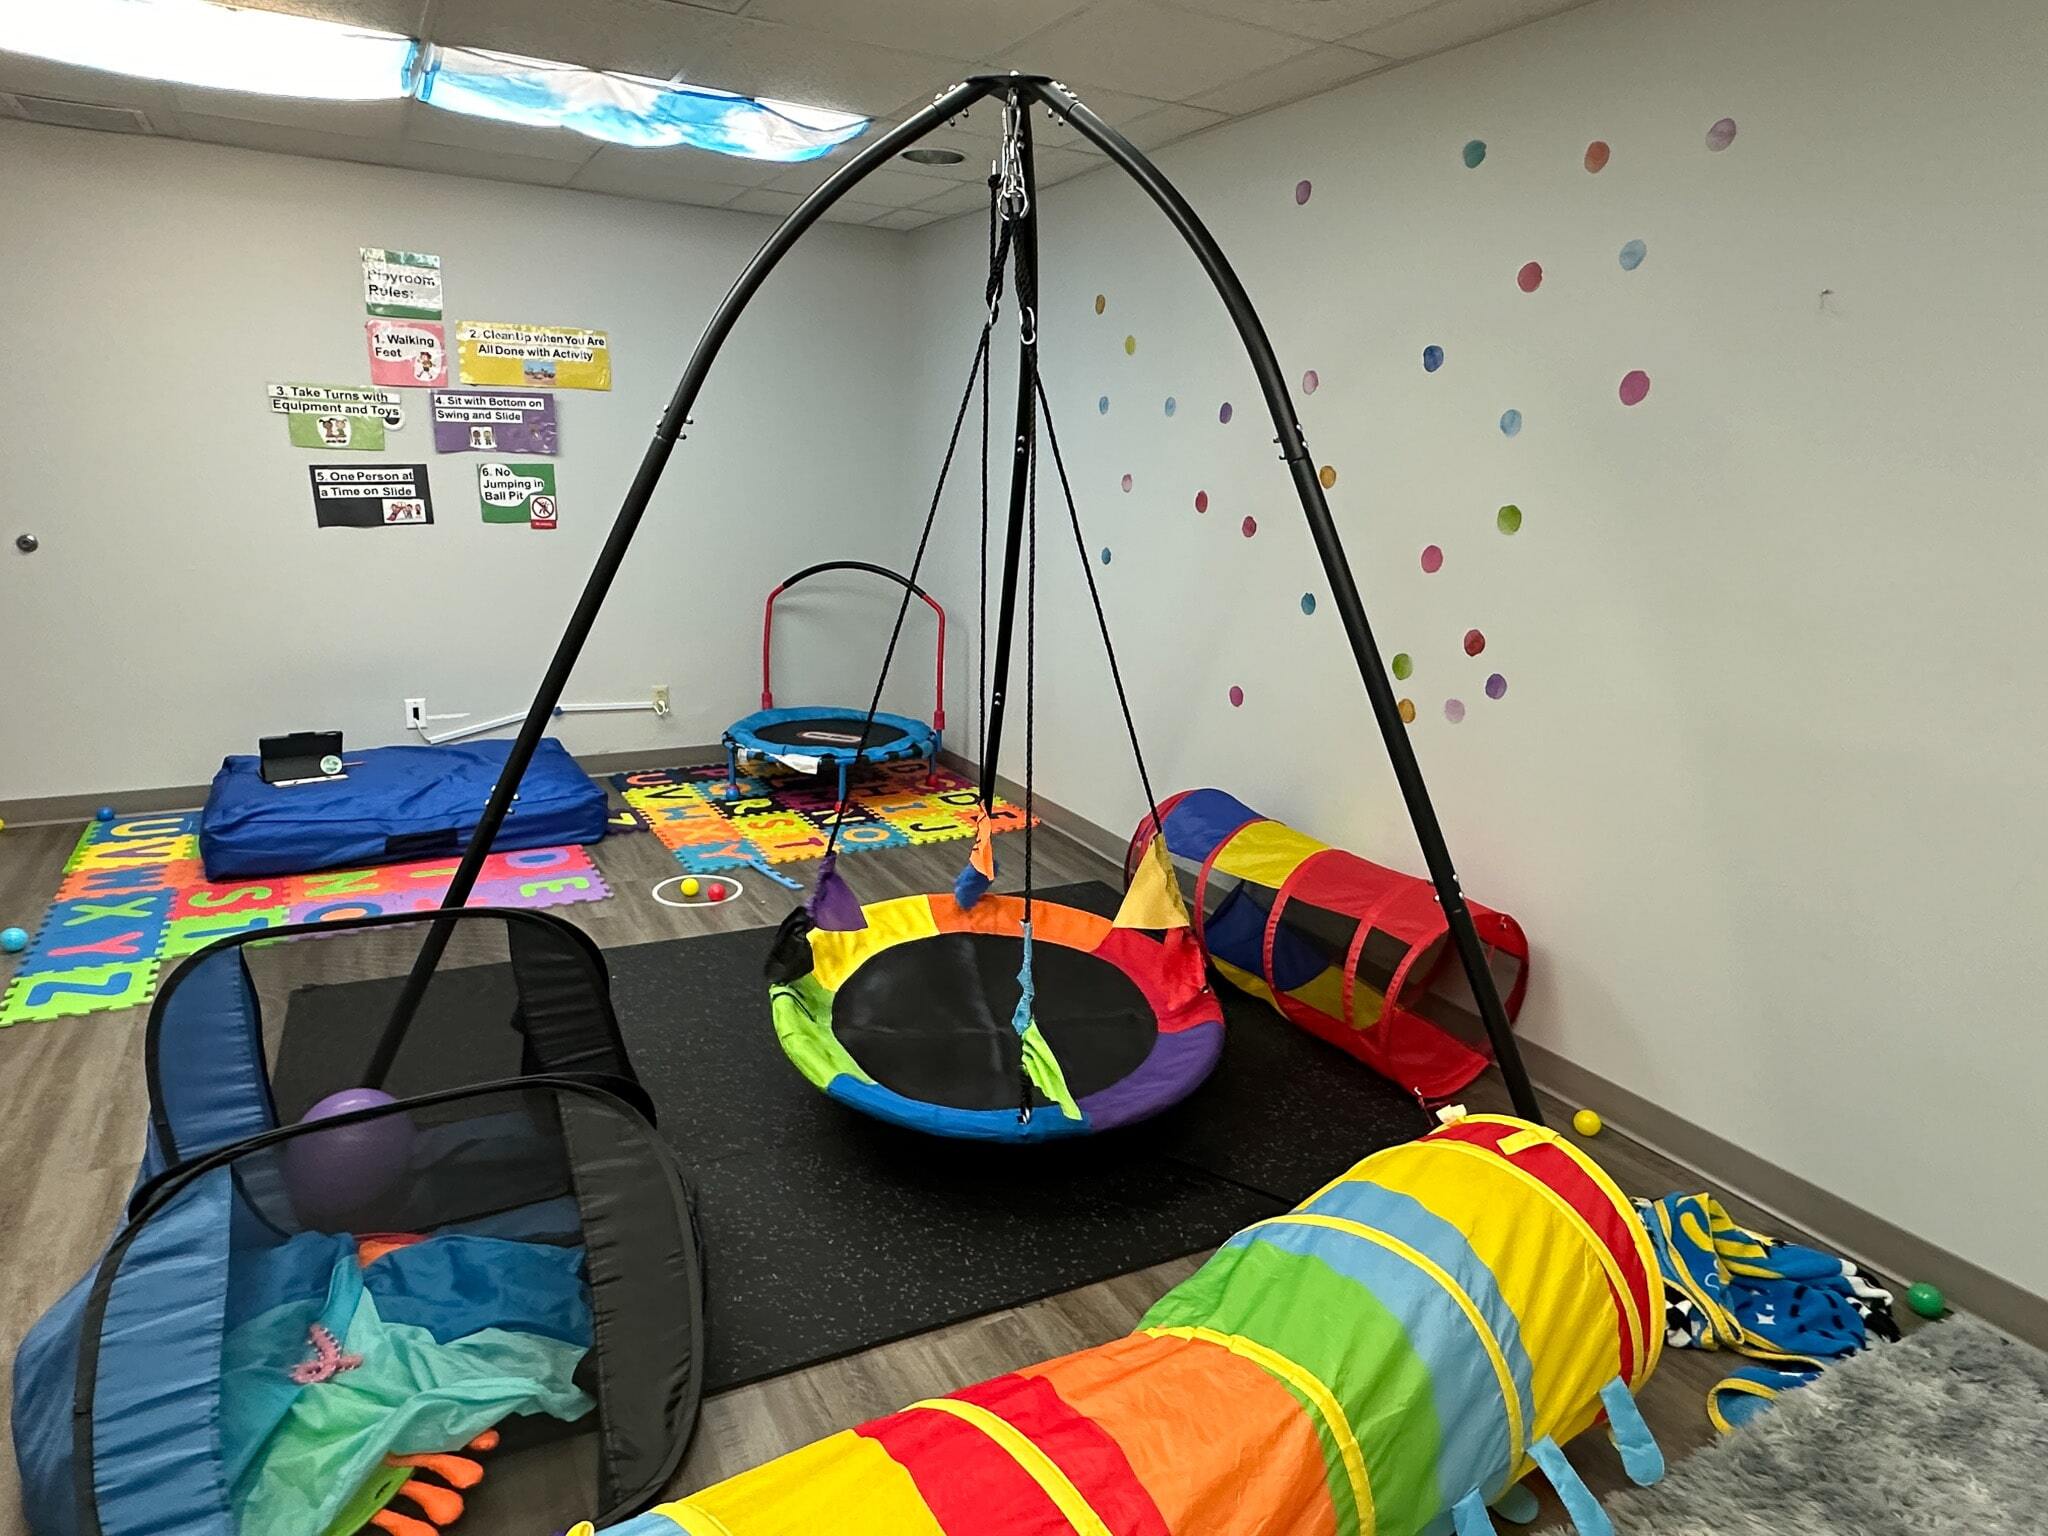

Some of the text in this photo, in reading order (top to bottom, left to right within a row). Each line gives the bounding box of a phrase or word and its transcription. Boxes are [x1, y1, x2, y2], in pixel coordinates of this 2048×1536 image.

[368, 284, 414, 299] Rules:
[374, 334, 434, 348] 1. Walking
[565, 337, 585, 345] You
[587, 337, 605, 346] Are
[375, 347, 402, 357] Feet
[478, 344, 593, 361] All Done with Activity
[276, 386, 388, 402] 3. Take Turns with
[447, 396, 461, 405] Sit
[464, 397, 486, 406] with
[489, 398, 526, 407] Bottom
[273, 399, 399, 417] Equipment and Toys
[438, 410, 520, 420] Swing and Slide
[317, 472, 413, 481] 5. One Person at
[482, 468, 510, 476] 6. No
[331, 487, 360, 496] Time
[383, 487, 411, 496] Slide
[483, 480, 544, 490] Jumping in
[485, 491, 524, 500] Ball Pit
[725, 798, 772, 814] R
[110, 817, 184, 837] U
[96, 841, 175, 858] V
[303, 870, 378, 897] N
[519, 877, 590, 897] E
[188, 886, 272, 907] S
[62, 897, 157, 927] X
[47, 931, 145, 957] Y
[25, 971, 133, 1006] Z
